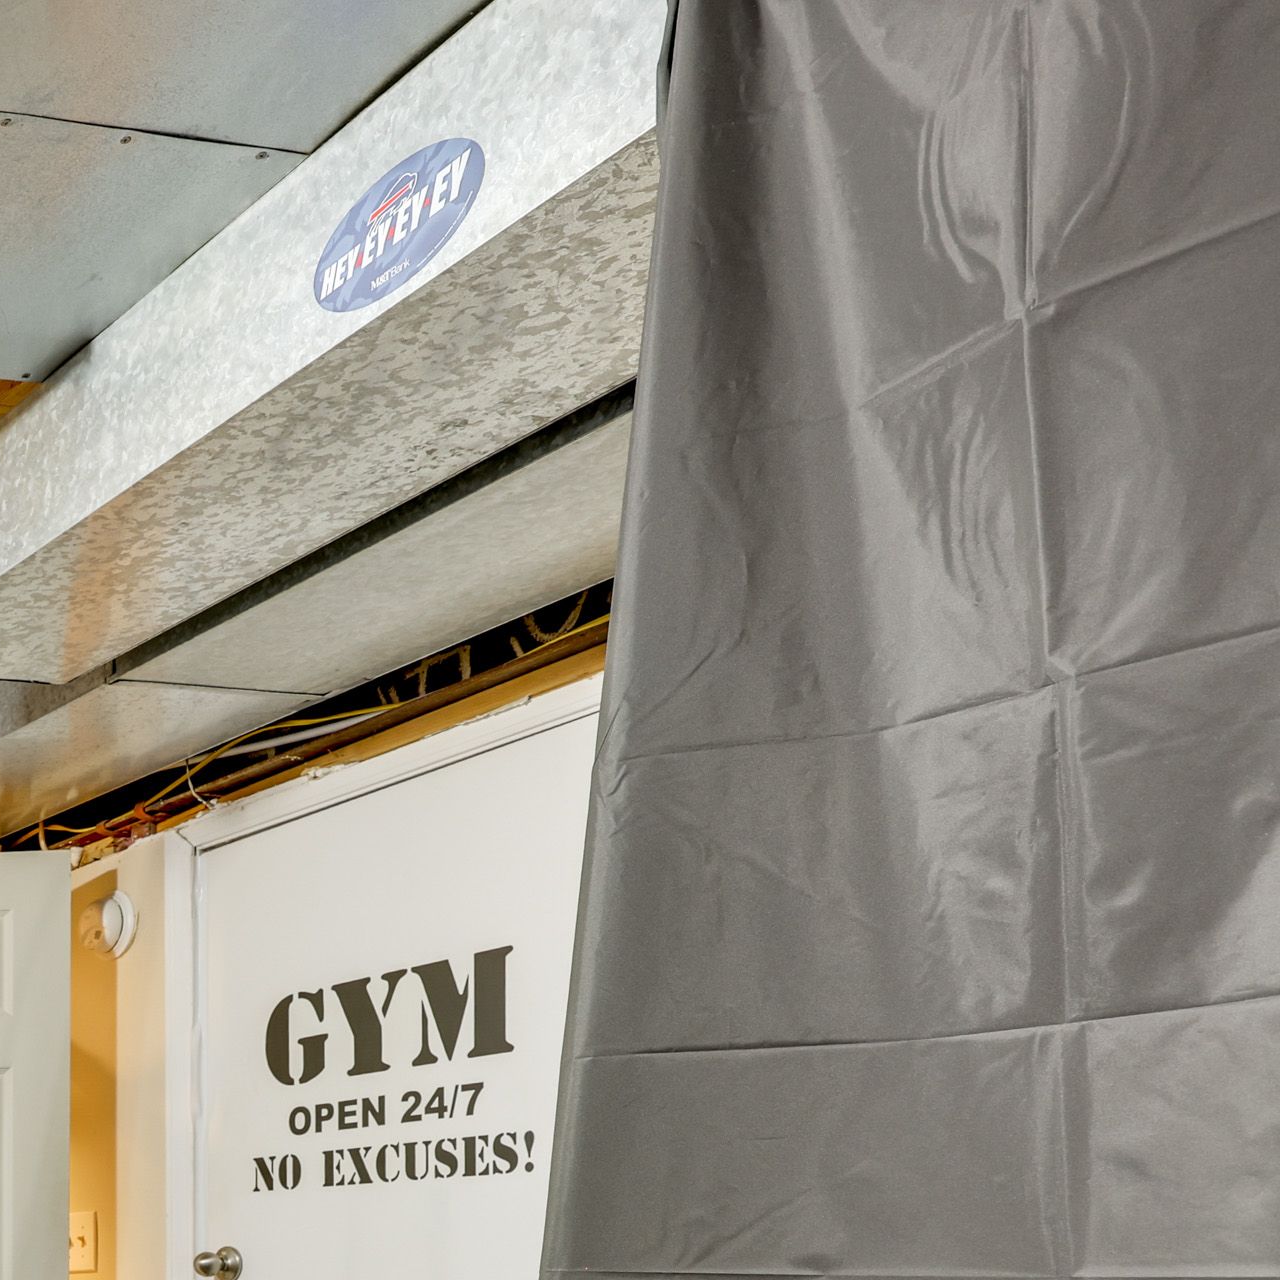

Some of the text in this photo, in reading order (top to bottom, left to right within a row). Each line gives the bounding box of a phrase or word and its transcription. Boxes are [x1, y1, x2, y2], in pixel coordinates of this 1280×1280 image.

[264, 944, 515, 1086] GYM
[288, 1082, 485, 1136] OPEN 24/7
[252, 1130, 536, 1192] NO EXCUSES!
